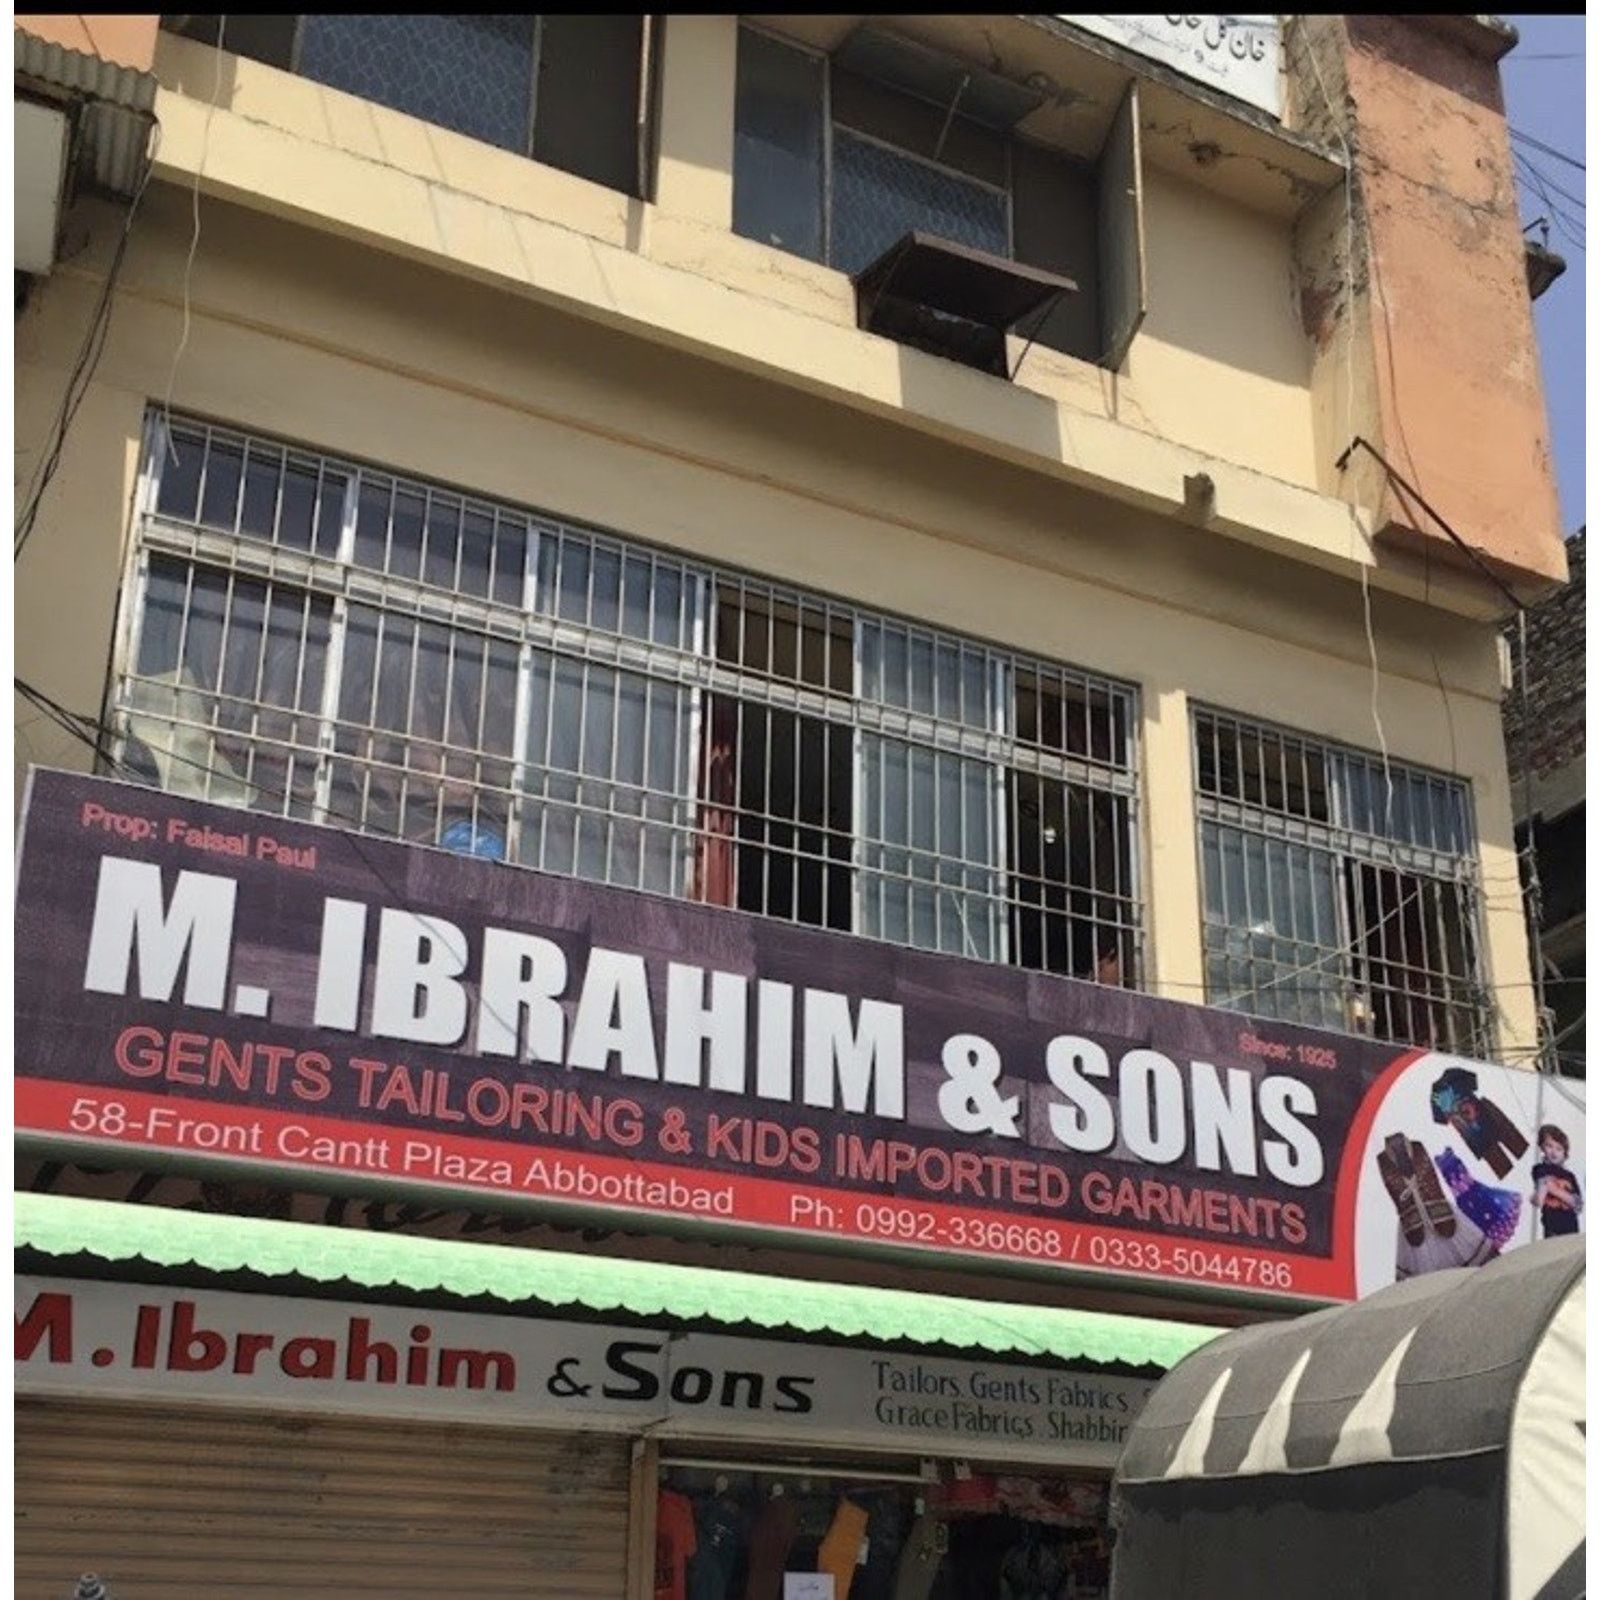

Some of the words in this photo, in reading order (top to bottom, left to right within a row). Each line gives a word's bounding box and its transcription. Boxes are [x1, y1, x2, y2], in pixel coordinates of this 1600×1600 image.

[81, 802, 158, 842] Prop:
[166, 818, 248, 857] Faisal
[256, 835, 317, 870] Paul
[84, 855, 270, 1018] M.
[313, 896, 905, 1121] IBRAHIM
[938, 1032, 1021, 1139] &
[1045, 1034, 1325, 1188] SONS
[68, 1098, 263, 1155] 58-Front
[277, 1124, 390, 1169] Cantt
[403, 1140, 513, 1185] Plaza
[523, 1158, 735, 1215] Abbottabad
[790, 1194, 844, 1230] Ph:
[855, 1203, 1062, 1258] 0992-336668
[1070, 1236, 1082, 1261] /
[1089, 1235, 1294, 1289] 0333-5044786
[114, 1026, 333, 1102] GENTS
[348, 1057, 645, 1147] TAILORING
[657, 1107, 693, 1156] &
[706, 1113, 821, 1173] KIDS
[835, 1132, 1070, 1208] IMPORTED
[1080, 1172, 1308, 1244] GARMENTS
[969, 1370, 1041, 1405] Gents
[1047, 1378, 1129, 1413] Fabrics
